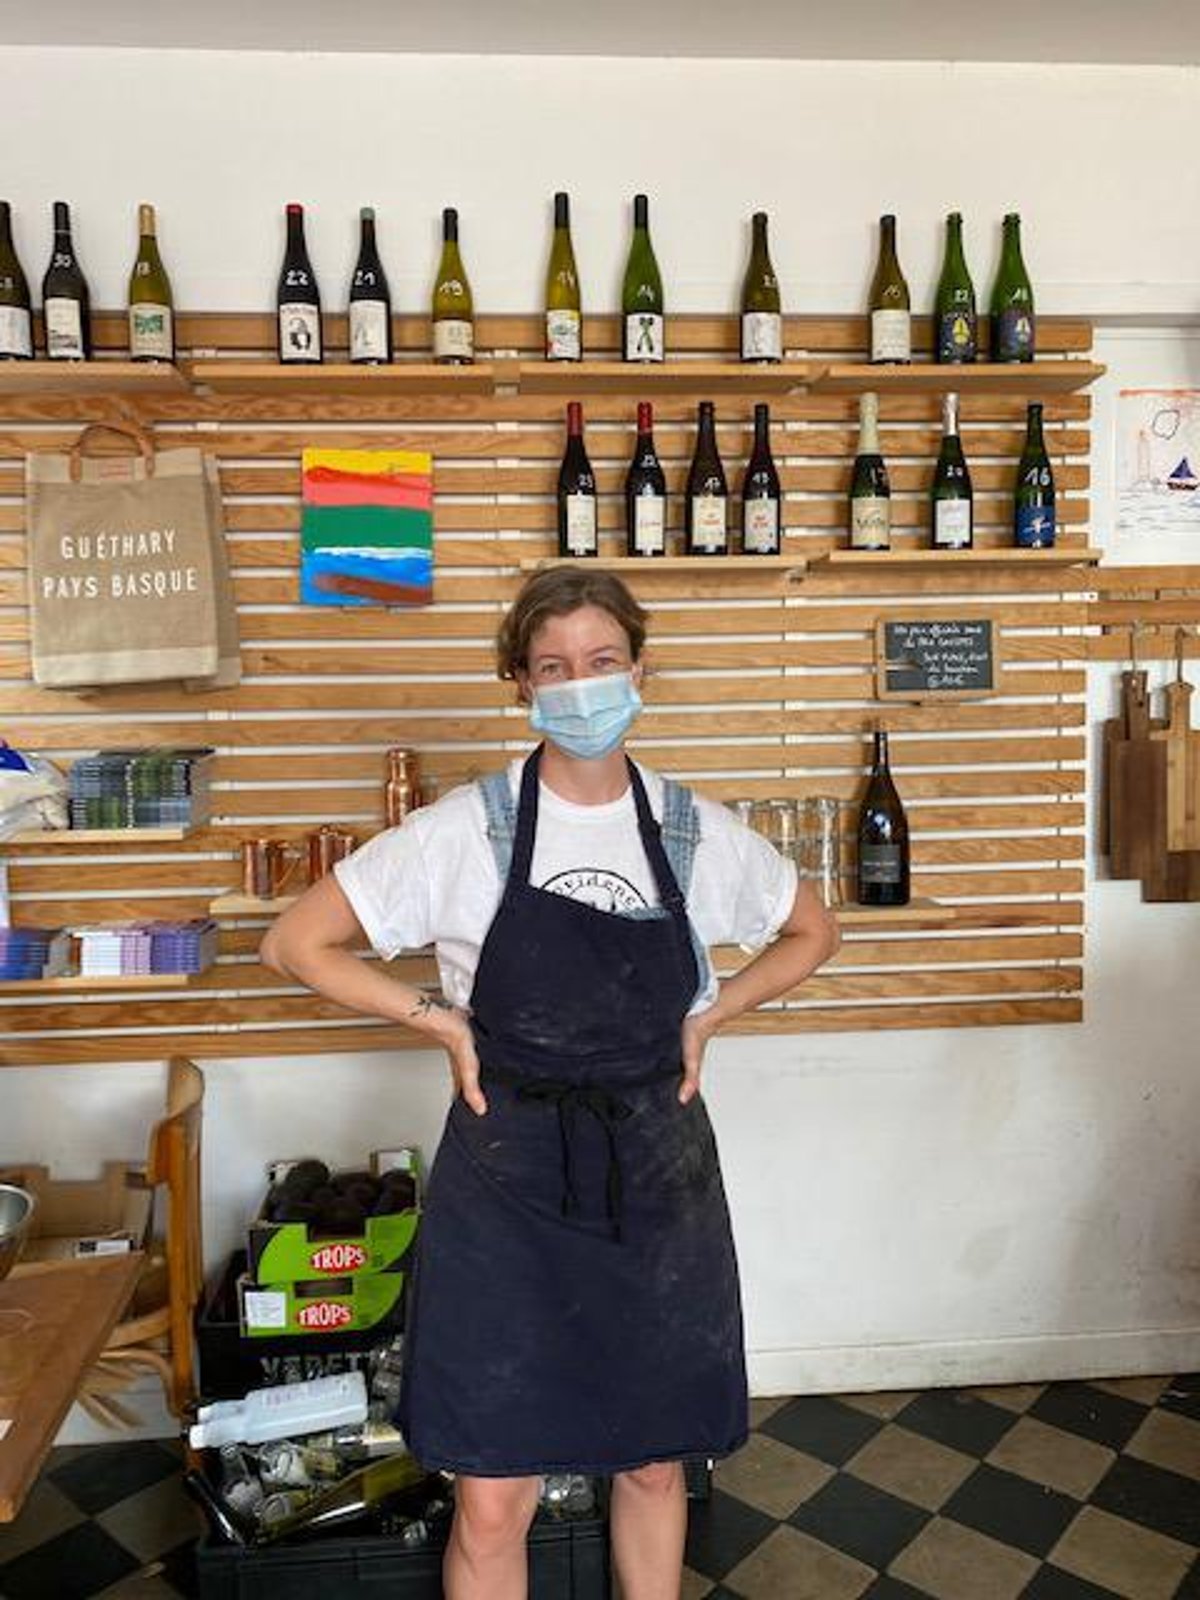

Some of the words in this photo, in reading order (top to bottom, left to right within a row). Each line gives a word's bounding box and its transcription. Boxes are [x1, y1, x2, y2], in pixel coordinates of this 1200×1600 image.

[286, 270, 308, 286] 22
[1024, 466, 1050, 486] 16
[61, 528, 177, 562] GUÉTHARY
[43, 575, 99, 599] PAYS
[111, 567, 198, 599] BASQUE
[312, 1244, 367, 1270] TROPS
[299, 1302, 353, 1328] TROPS
